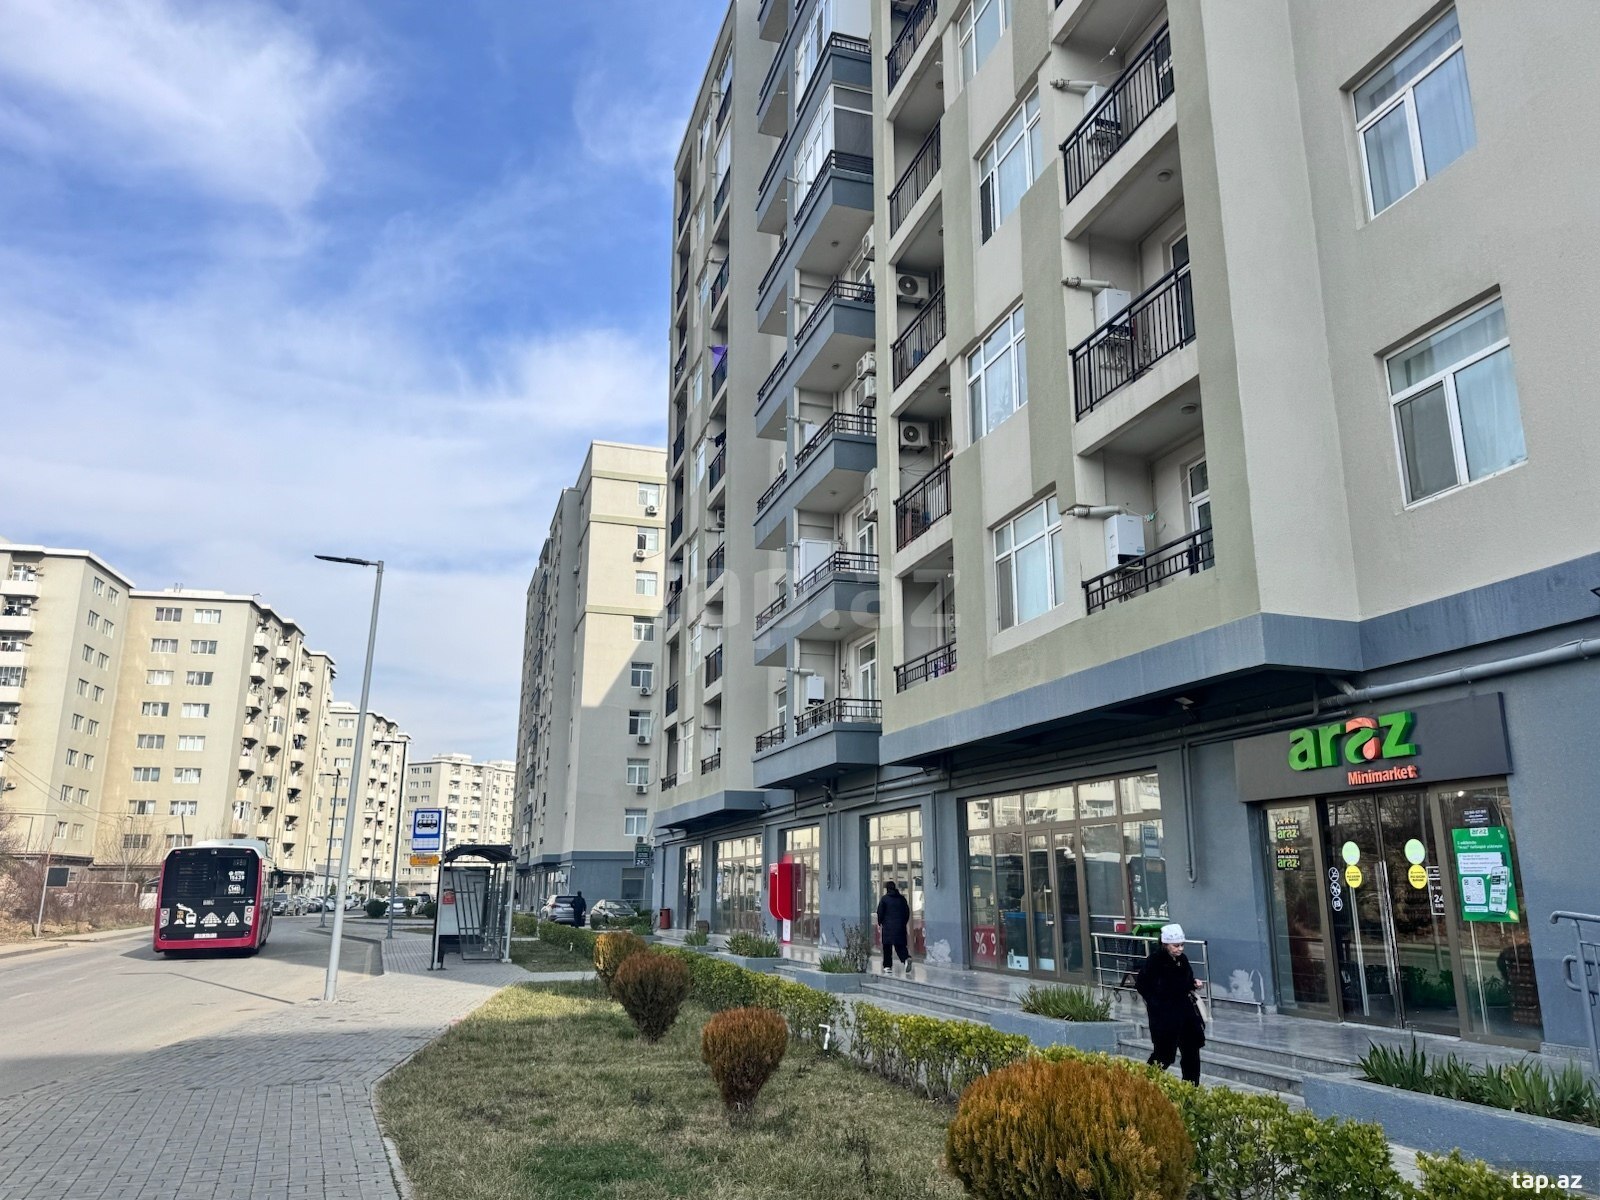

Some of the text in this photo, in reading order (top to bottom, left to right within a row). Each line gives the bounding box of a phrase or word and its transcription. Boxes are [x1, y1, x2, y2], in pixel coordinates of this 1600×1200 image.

[1288, 711, 1416, 771] araz
[1347, 765, 1417, 785] Minimarket
[1277, 829, 1298, 839] araz
[1277, 859, 1298, 868] araz
